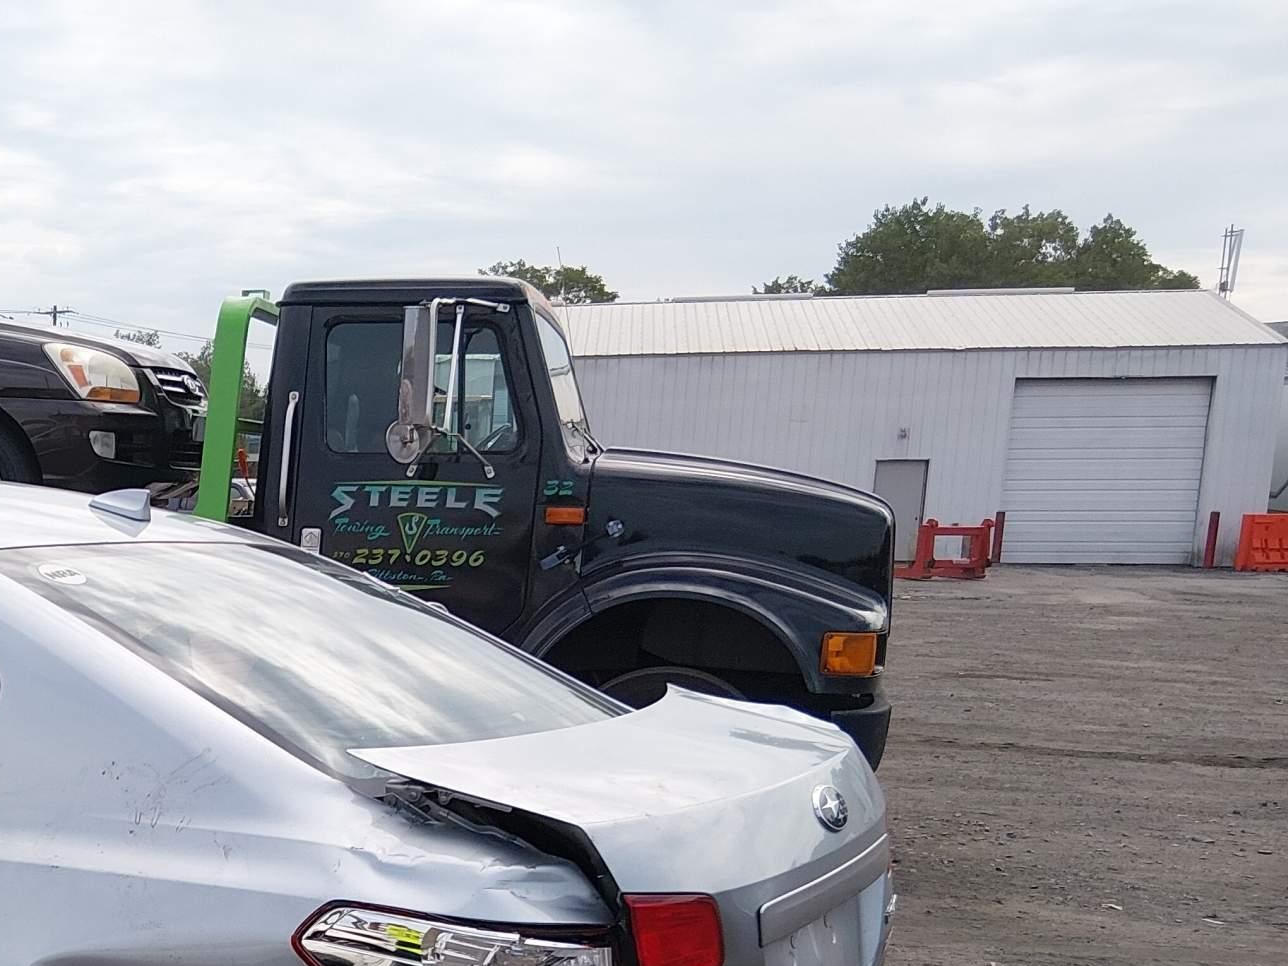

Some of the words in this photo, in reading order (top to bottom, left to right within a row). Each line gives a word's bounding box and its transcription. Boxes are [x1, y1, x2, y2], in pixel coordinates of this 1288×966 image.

[543, 480, 574, 496] 32
[328, 486, 505, 520] STEELE
[334, 517, 392, 540] Towing
[423, 518, 504, 539] Transport
